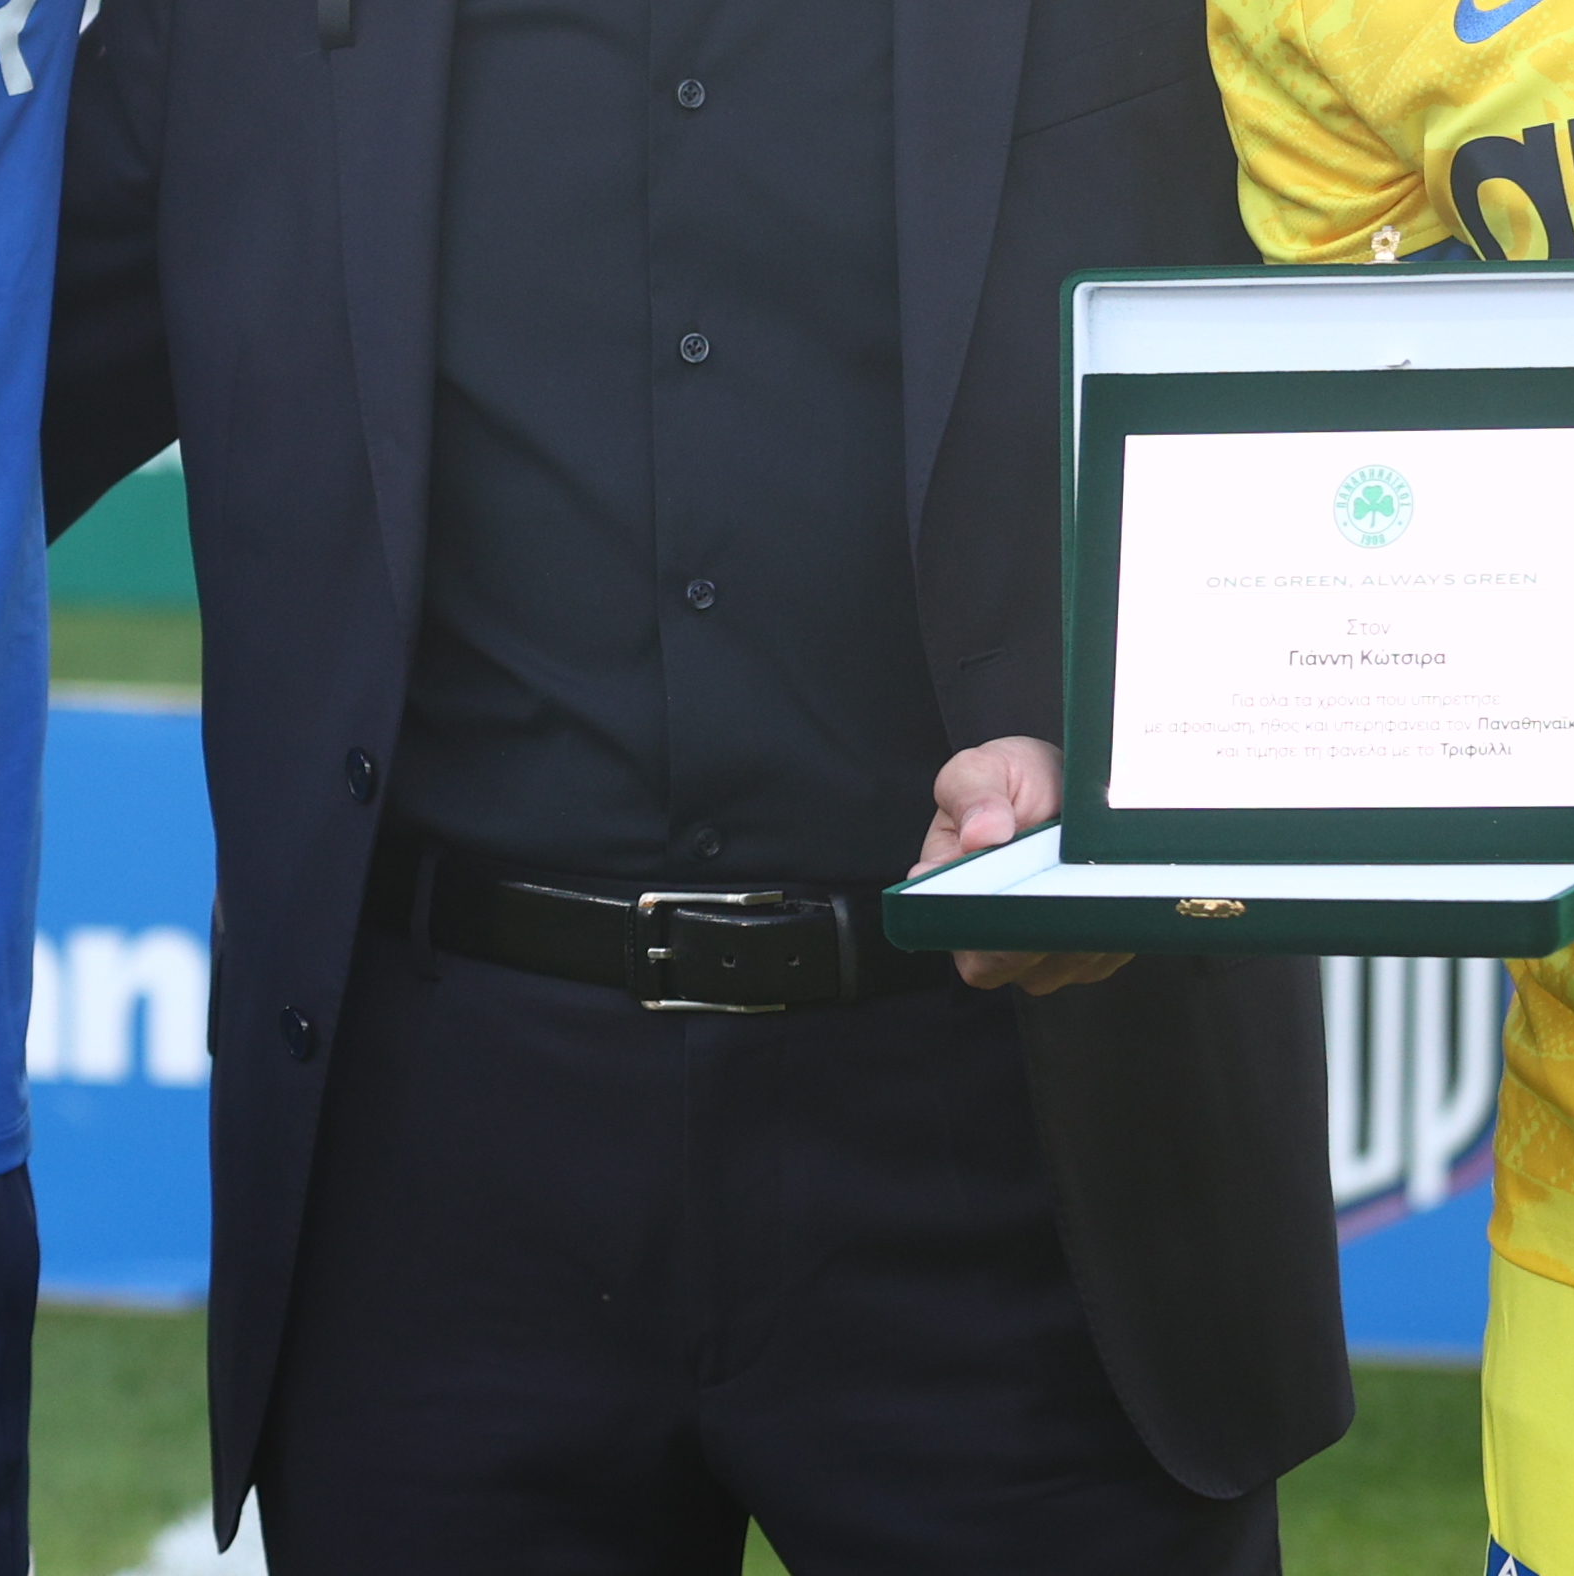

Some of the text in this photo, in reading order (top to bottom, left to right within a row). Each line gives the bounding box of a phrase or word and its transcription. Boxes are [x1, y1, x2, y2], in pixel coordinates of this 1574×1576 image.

[1360, 533, 1386, 546] 1908
[1205, 572, 1538, 590] ONCE GREEN, ALWAYS GREEN
[1346, 618, 1391, 636] Στον
[1231, 692, 1255, 708] Για
[1293, 696, 1313, 707] τα
[1375, 695, 1407, 707] που
[1144, 722, 1163, 736] με
[1305, 721, 1329, 732] και
[1445, 720, 1473, 732] τον
[1216, 747, 1240, 758] και
[1303, 746, 1322, 761] τη
[1391, 746, 1411, 760] με
[1415, 745, 1435, 757] το
